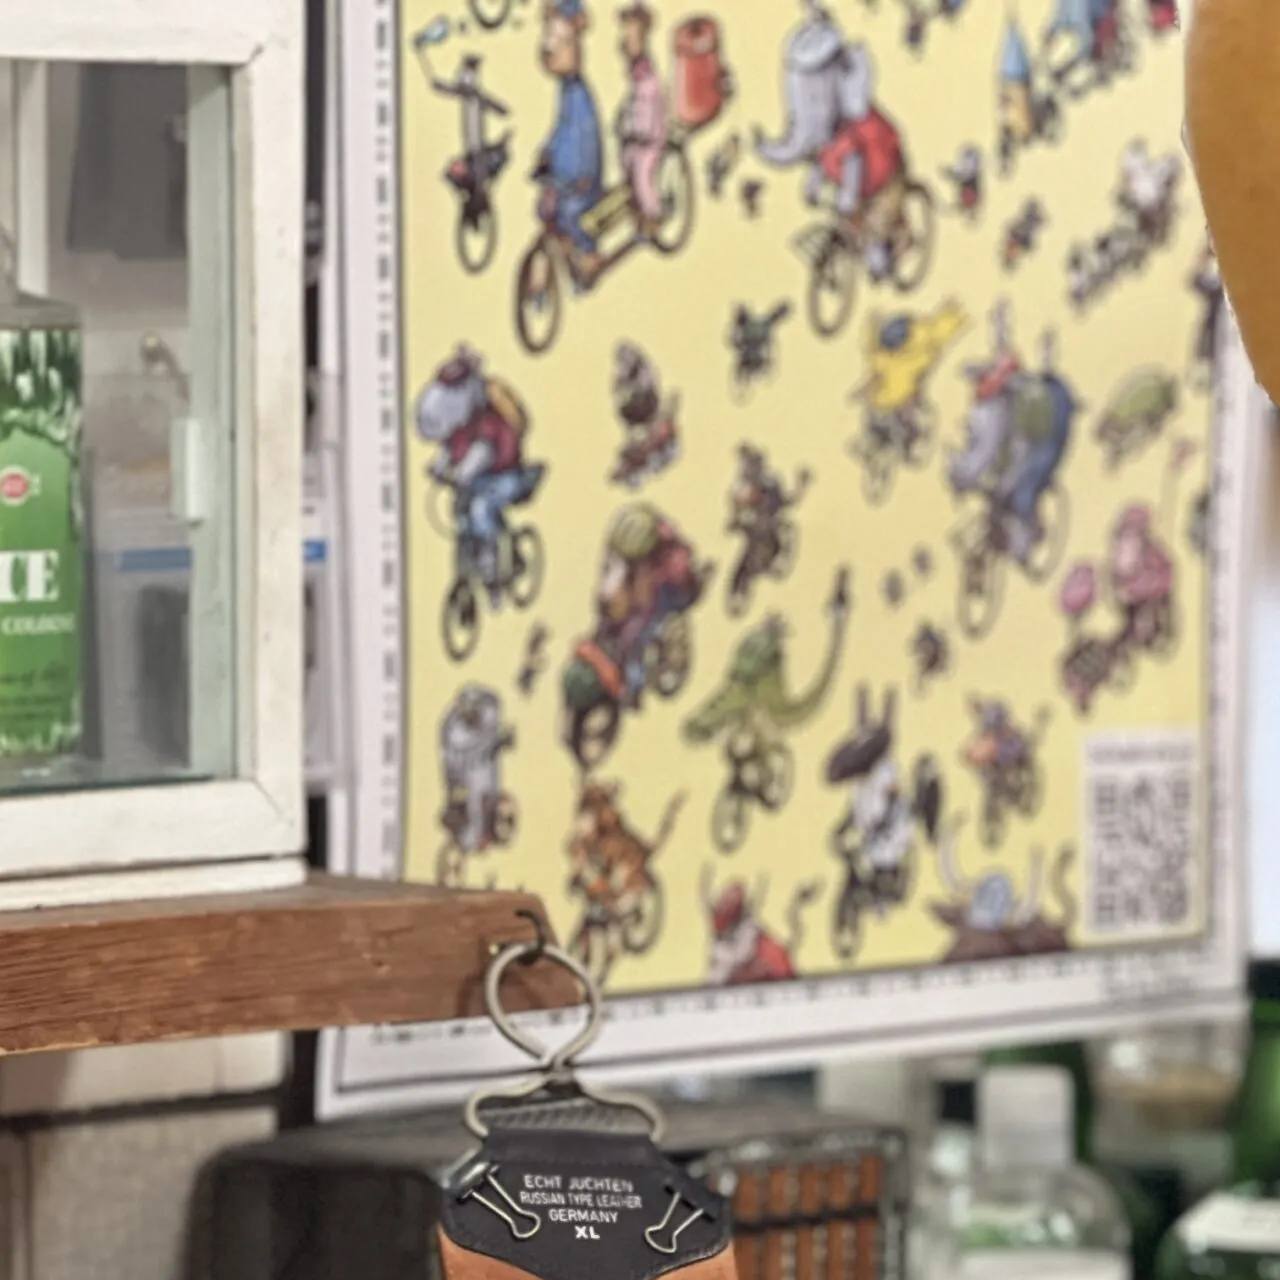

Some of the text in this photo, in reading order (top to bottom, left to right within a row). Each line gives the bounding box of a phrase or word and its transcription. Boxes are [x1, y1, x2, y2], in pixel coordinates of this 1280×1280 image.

[523, 1174, 634, 1193] ECHT JUCHTEN
[519, 1191, 566, 1205] RUSSIAN
[567, 1193, 594, 1207] TYPE
[548, 1207, 618, 1223] GERMANY
[574, 1225, 601, 1239] XL
